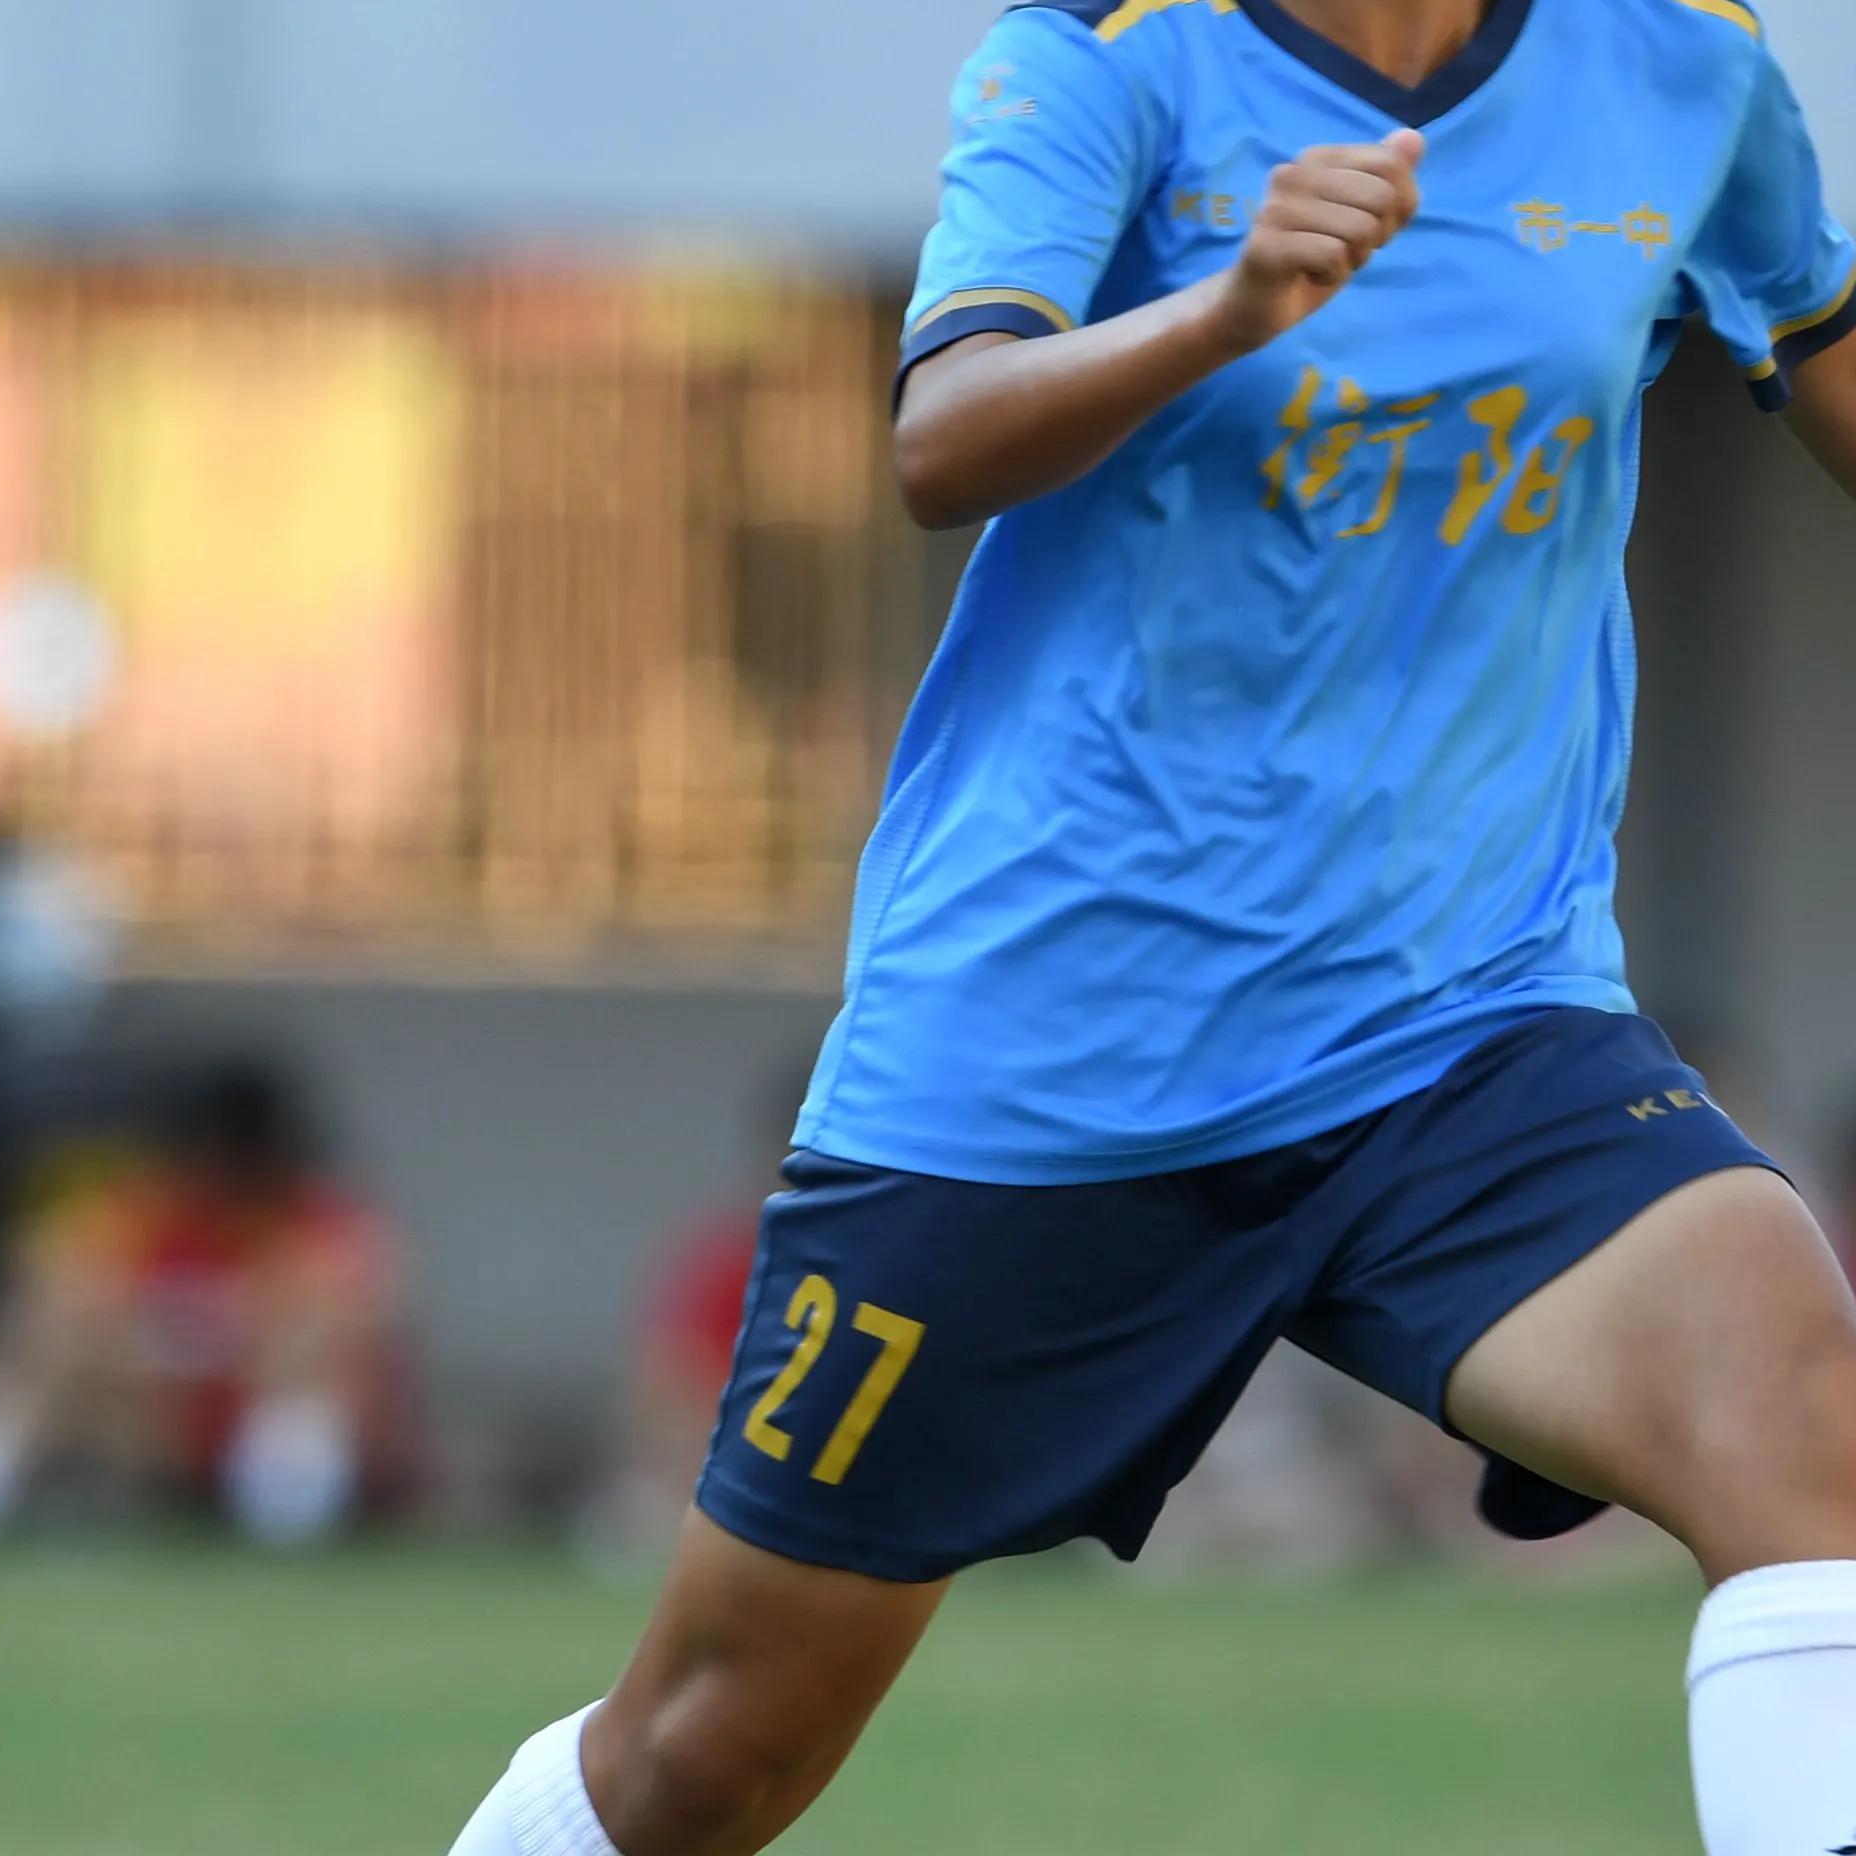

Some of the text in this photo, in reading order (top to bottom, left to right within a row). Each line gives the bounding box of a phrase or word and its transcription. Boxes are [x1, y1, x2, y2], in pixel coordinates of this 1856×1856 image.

[1510, 197, 1673, 260] 市一中
[1259, 364, 1596, 546] 衡阳
[1625, 1089, 1728, 1121] KE
[741, 1274, 926, 1485] 27
